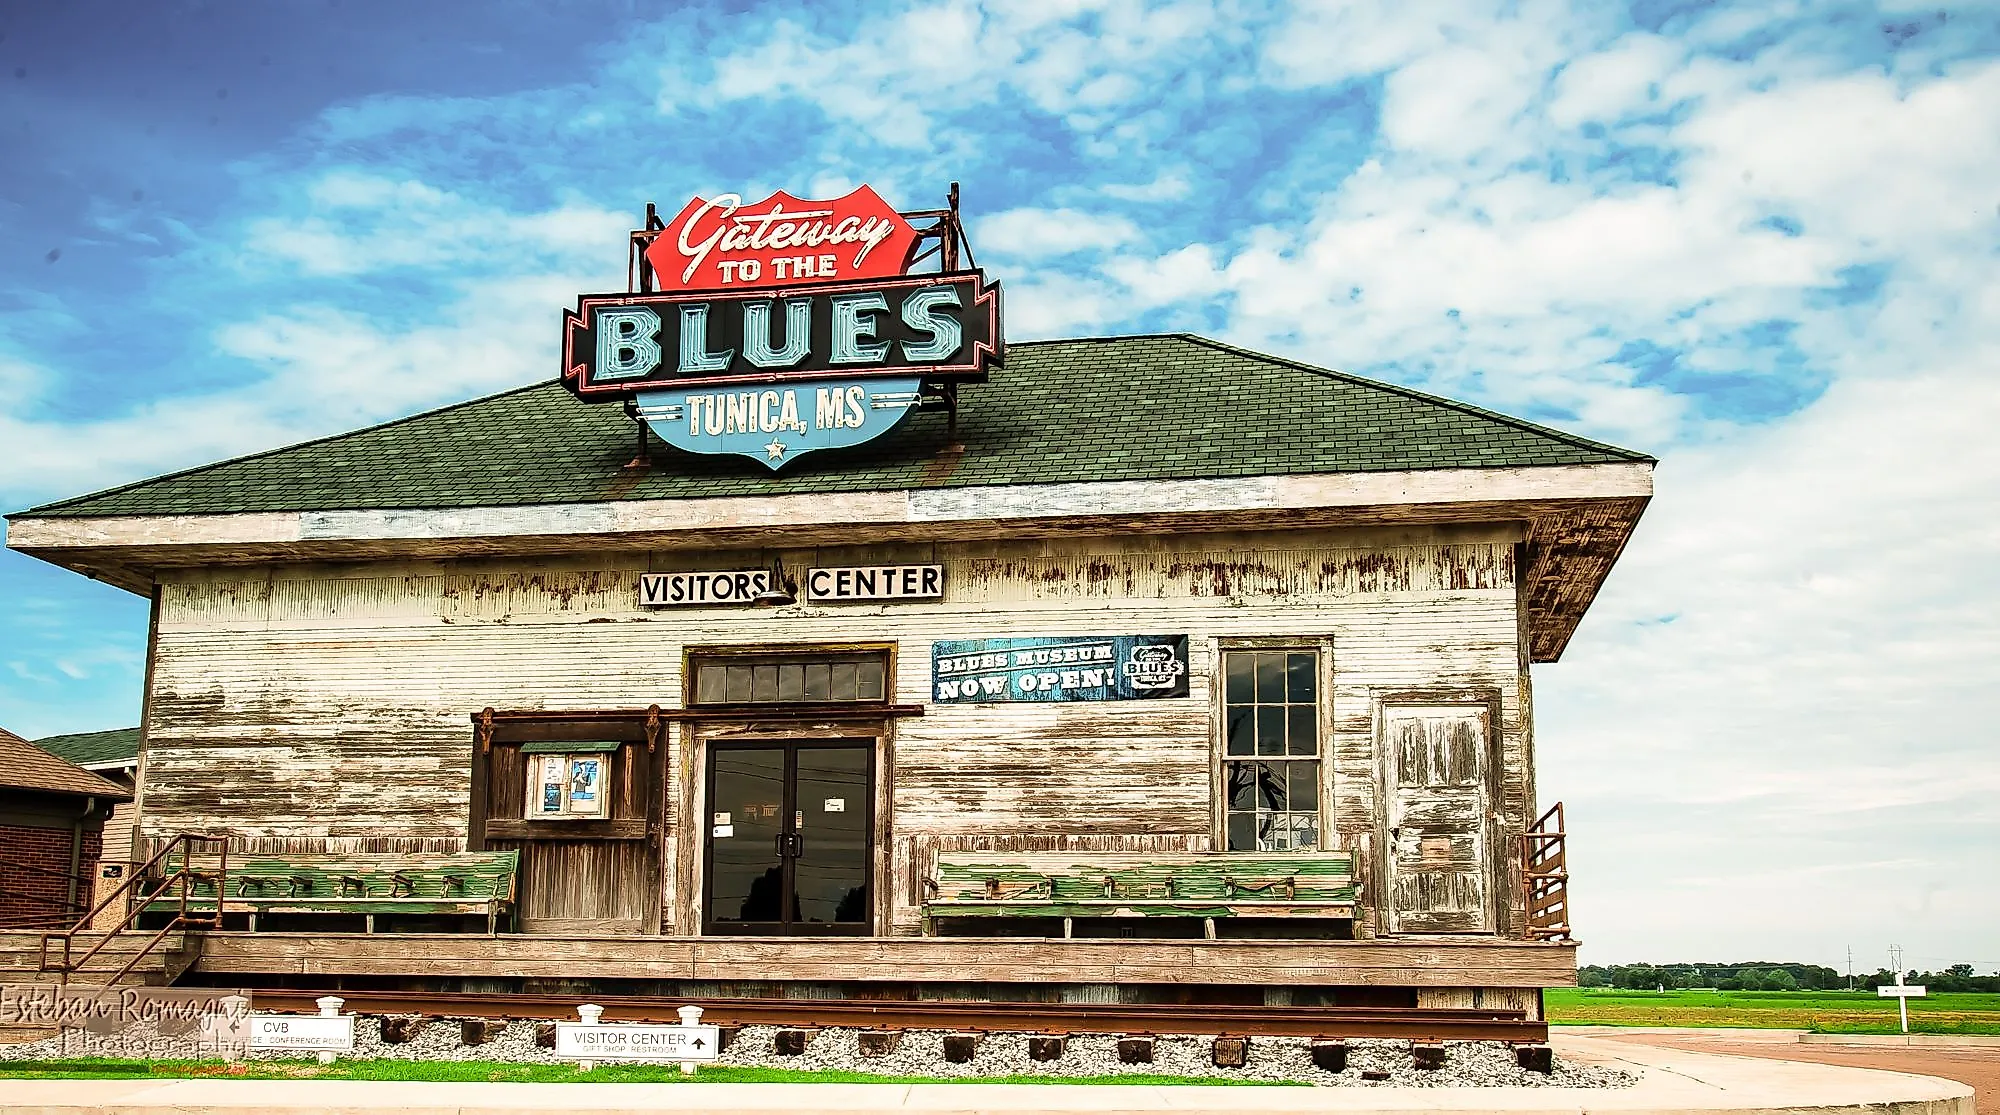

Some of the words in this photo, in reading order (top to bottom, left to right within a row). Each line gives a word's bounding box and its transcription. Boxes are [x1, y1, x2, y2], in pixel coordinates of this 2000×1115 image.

[678, 193, 895, 284] Gateway
[717, 259, 761, 284] TO
[770, 254, 838, 278] THE
[593, 284, 964, 381] BLUES
[685, 392, 807, 436] TUNICA,
[816, 386, 865, 429] MS
[642, 573, 767, 601] VISITORS
[810, 568, 939, 596] CENTER
[937, 652, 1008, 673] BLUES
[1016, 646, 1113, 666] MUSEUM
[1127, 662, 1180, 674] BLUES
[938, 676, 1008, 699] NOW
[1018, 668, 1115, 692] OPEN!
[263, 1022, 289, 1033] CVB
[269, 1037, 321, 1045] CONFERENCE
[322, 1037, 346, 1045] ROOM
[574, 1032, 627, 1044] VISITOR
[631, 1033, 686, 1045] CENTER
